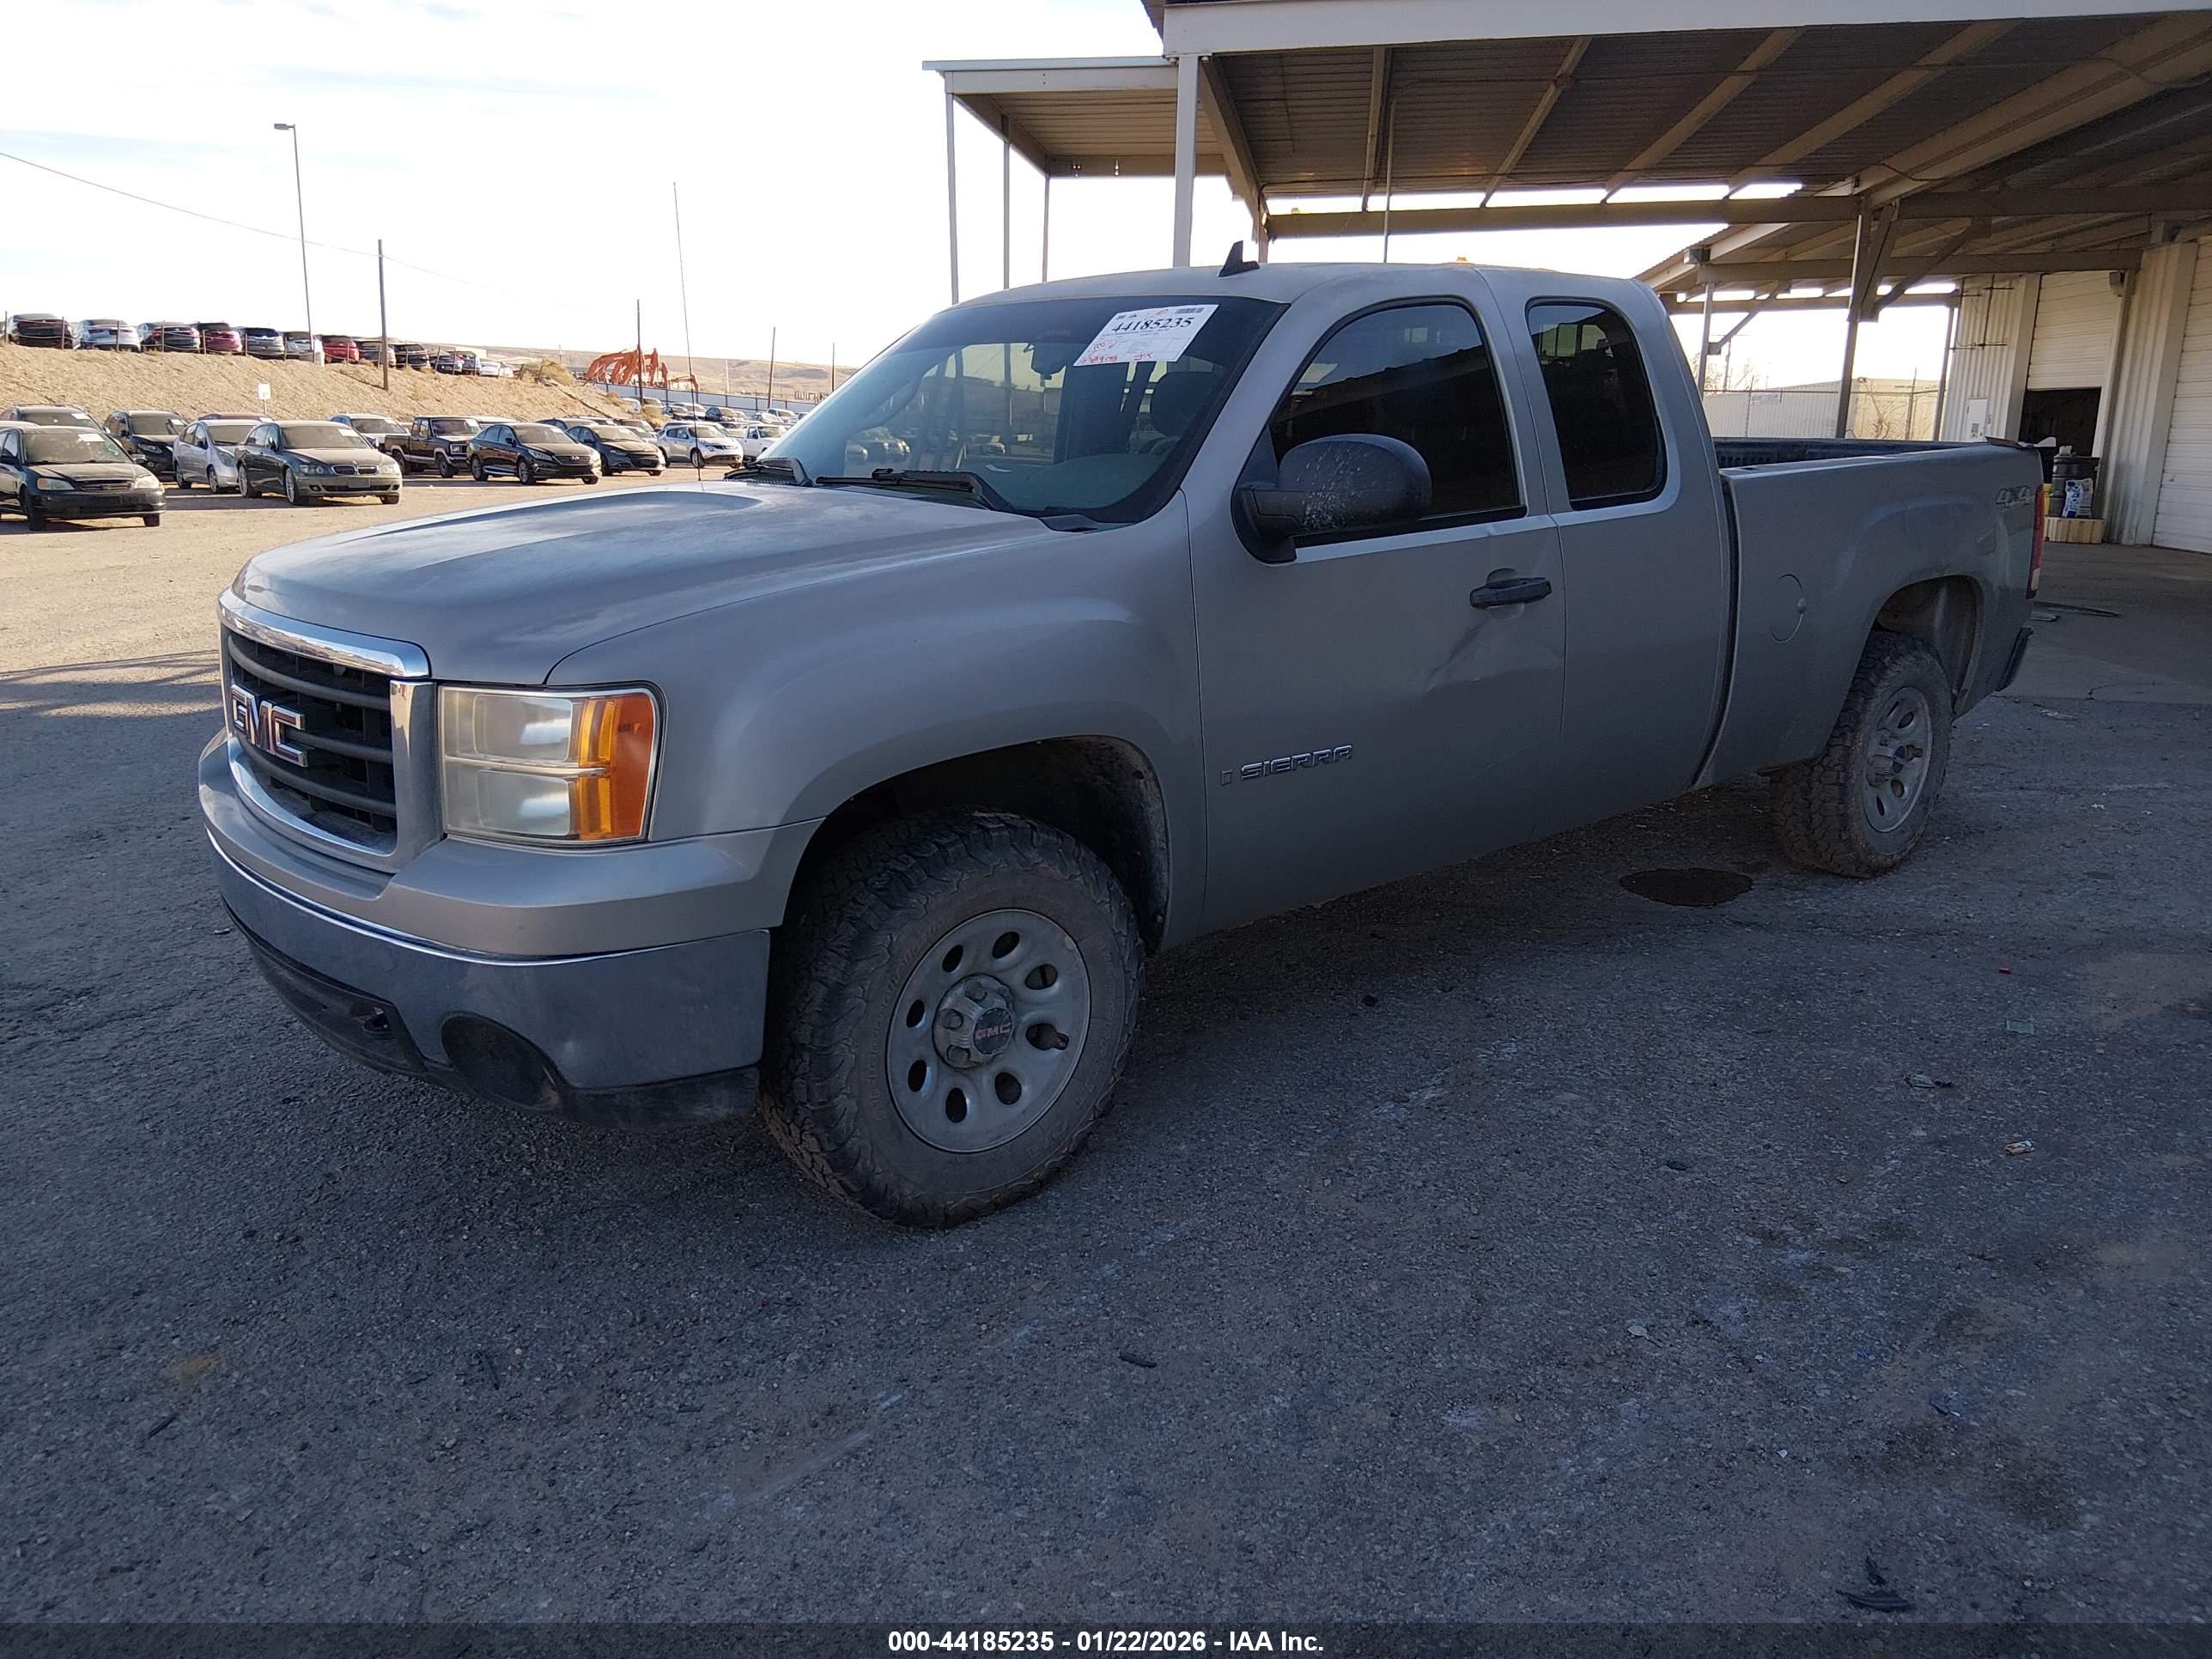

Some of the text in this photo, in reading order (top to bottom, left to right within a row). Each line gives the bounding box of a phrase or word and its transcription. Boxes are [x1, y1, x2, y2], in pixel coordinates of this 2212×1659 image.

[1111, 316, 1195, 332] 44185235
[230, 684, 308, 767] GMC
[1241, 744, 1353, 781] SIERRA
[975, 1022, 1012, 1040] GMC
